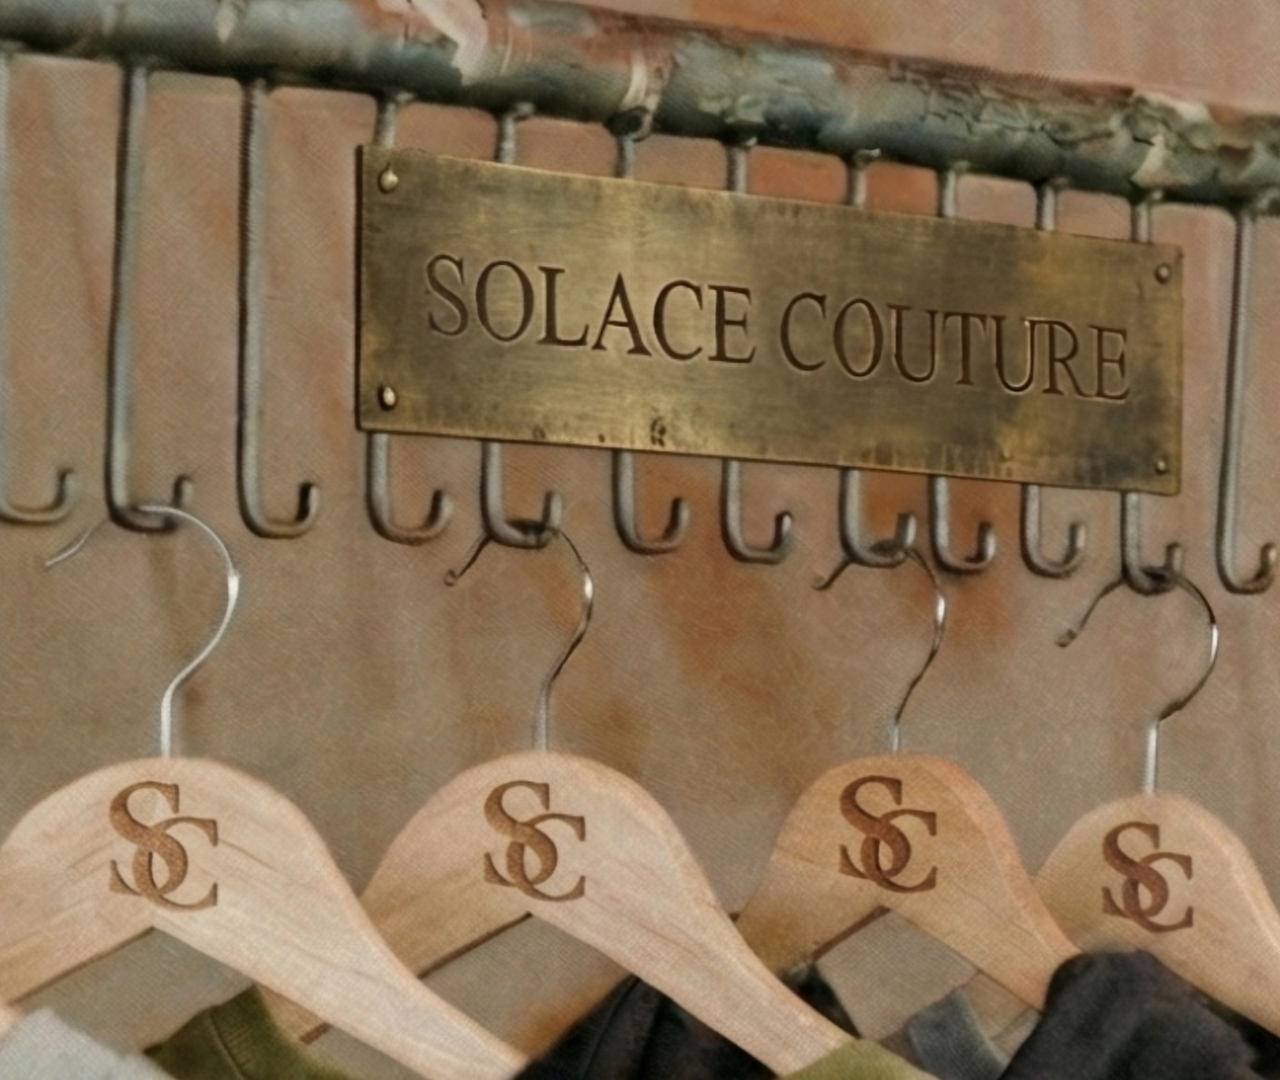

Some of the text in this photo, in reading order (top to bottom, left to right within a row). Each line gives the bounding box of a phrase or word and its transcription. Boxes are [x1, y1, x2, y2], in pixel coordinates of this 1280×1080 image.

[425, 254, 1131, 401] SOLACE COUTURE
[108, 780, 218, 911] SC
[483, 779, 586, 902] SC
[838, 775, 937, 893] SC
[1101, 820, 1194, 933] SC
